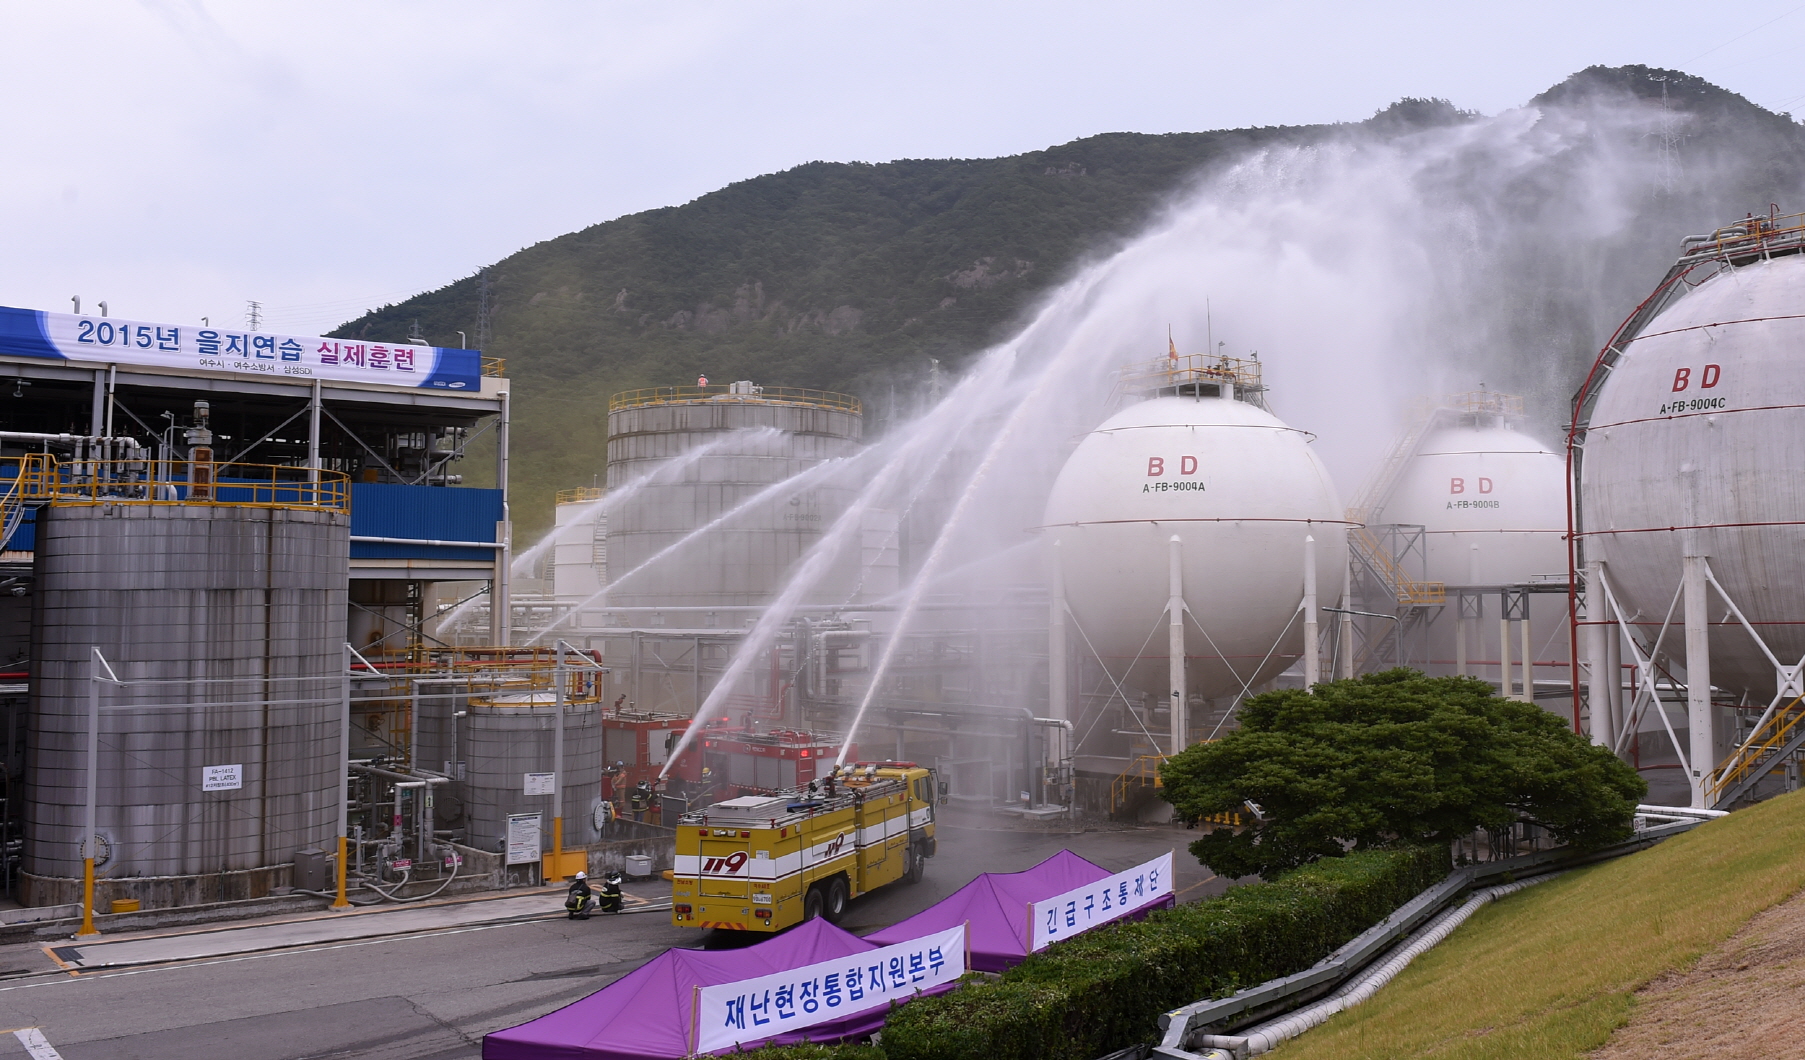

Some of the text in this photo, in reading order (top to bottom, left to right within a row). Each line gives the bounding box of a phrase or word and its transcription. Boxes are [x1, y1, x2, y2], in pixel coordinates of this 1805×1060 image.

[78, 320, 415, 372] 2015년 을지연습 실제훈련
[199, 359, 312, 375] 여수시 여수소방서 삼성SDI
[1660, 398, 1726, 414] A-FB-9004C
[1143, 482, 1206, 493] A-FB-9004A
[1446, 501, 1500, 509] A-FB-9004B
[825, 832, 845, 858] 119
[701, 852, 748, 874] 119
[724, 946, 945, 1029] 재난현장통합지원본부
